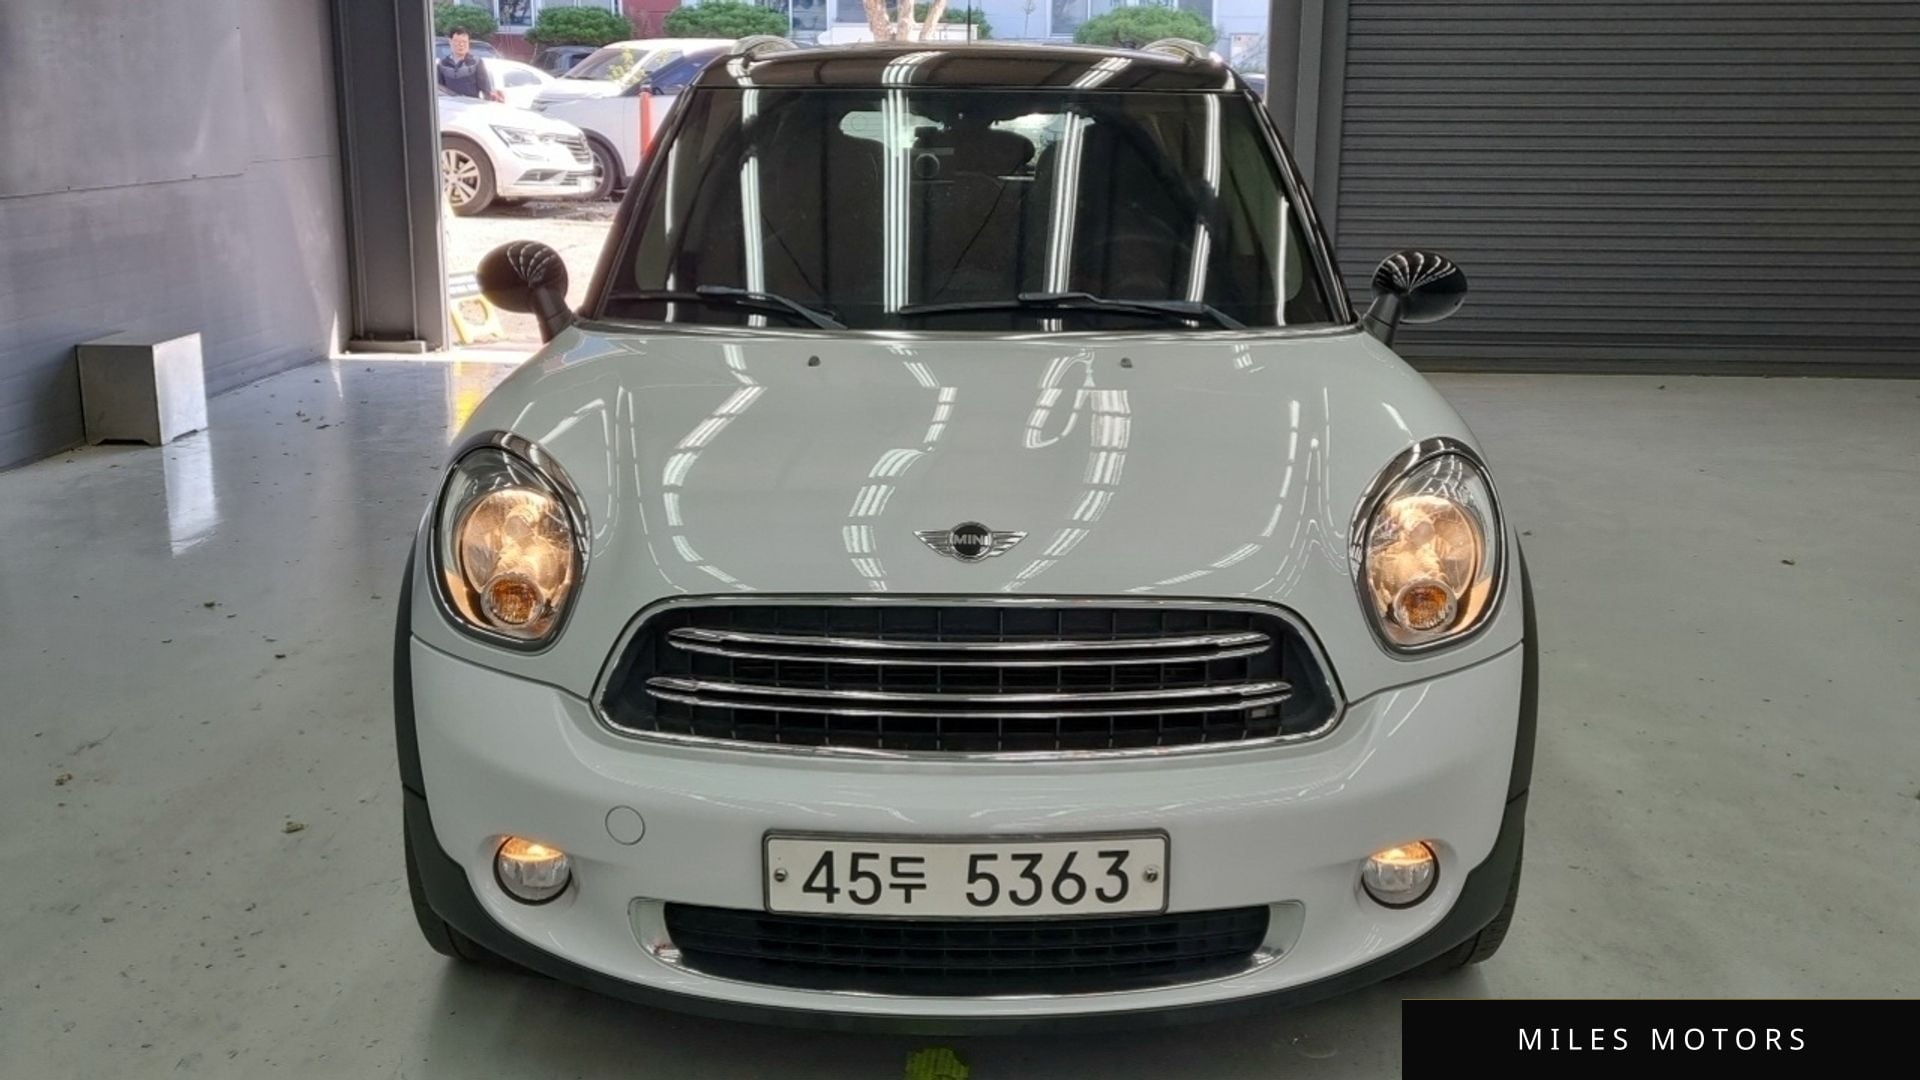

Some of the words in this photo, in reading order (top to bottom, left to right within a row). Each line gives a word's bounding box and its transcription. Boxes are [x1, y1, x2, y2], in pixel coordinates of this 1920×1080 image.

[953, 534, 988, 546] MINI
[802, 850, 927, 905] 45두
[965, 850, 1130, 907] 5363
